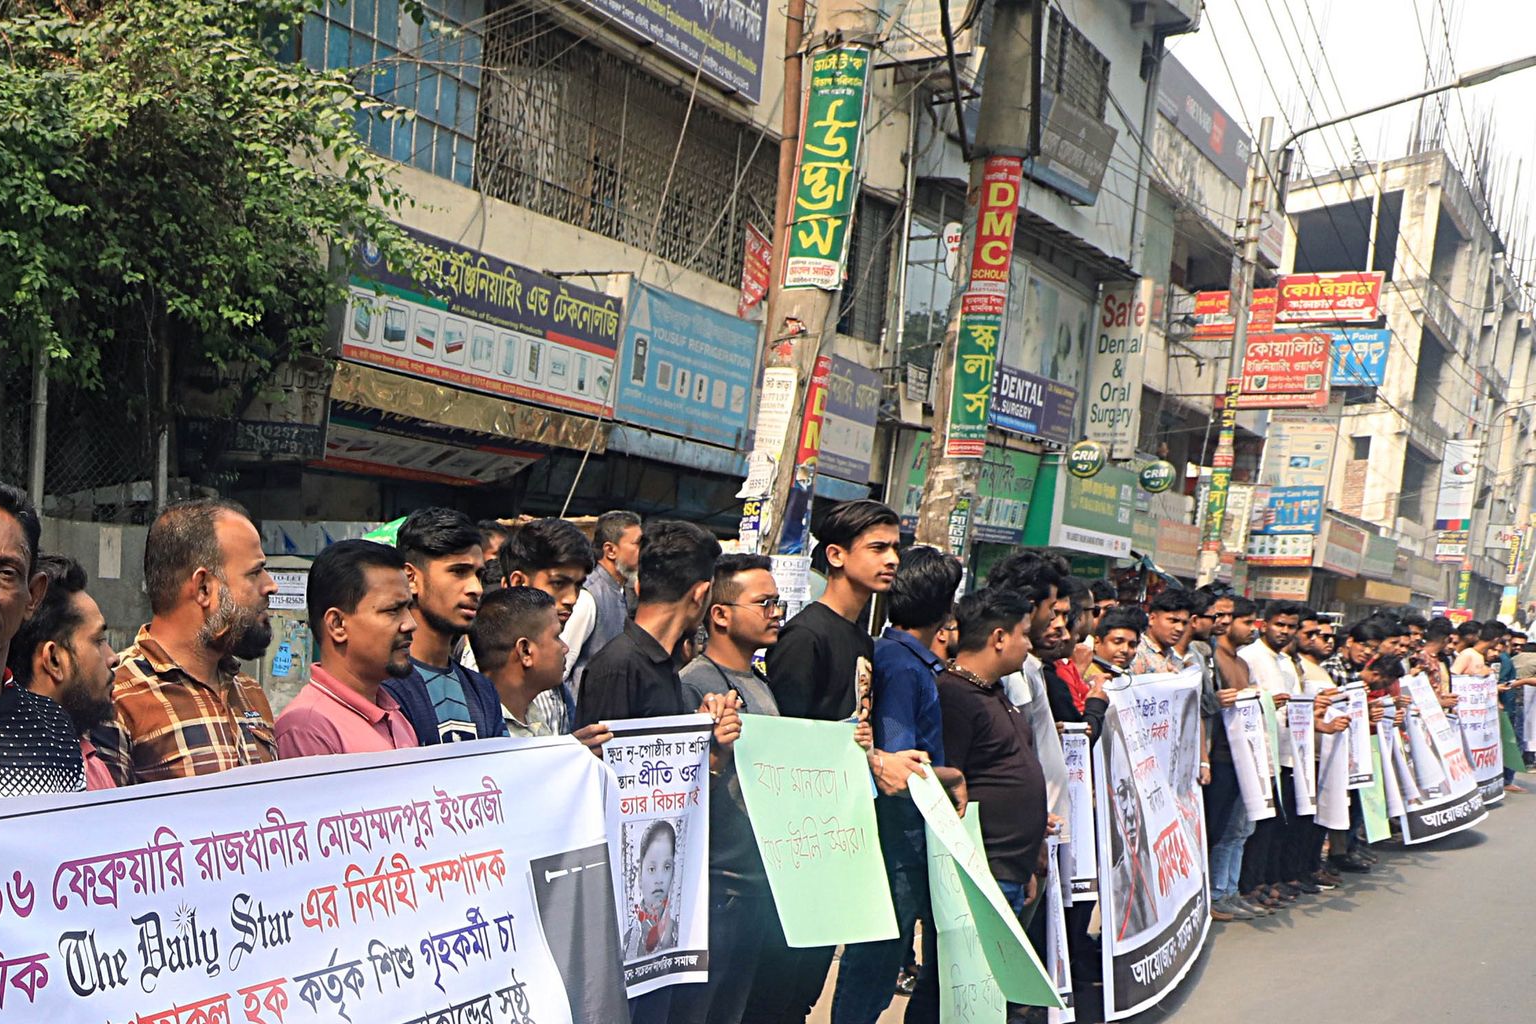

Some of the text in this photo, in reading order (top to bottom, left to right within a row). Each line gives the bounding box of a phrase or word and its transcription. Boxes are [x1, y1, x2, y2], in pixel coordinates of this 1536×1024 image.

[1112, 359, 1122, 378] &
[1000, 373, 1044, 407] DENTAL
[1002, 400, 1032, 420] SURGERY
[1072, 450, 1099, 461] CRM
[676, 742, 685, 755] চা
[689, 736, 709, 753] শ্রমি
[618, 775, 636, 789] ন্তান
[639, 760, 673, 787] প্রীতি
[620, 796, 648, 815] ত্যার
[652, 789, 686, 812] বিচার
[52, 826, 184, 912] ফেব্রুয়ারি
[191, 806, 308, 883] রাজধানীর
[316, 796, 433, 859] মোহাম্মদপুর
[434, 777, 504, 835] ইংরেজী
[58, 930, 128, 999] The
[135, 902, 220, 994] Daily
[230, 892, 296, 973] Star
[300, 876, 340, 933] এর
[344, 855, 417, 923] নির্বাহী
[421, 848, 506, 904] সম্পাদক
[294, 950, 364, 1023] কর্তৃক
[367, 937, 414, 994] শিশু
[419, 907, 489, 994] গৃহকর্মী
[494, 912, 517, 955] চা
[674, 955, 699, 966] সমাজ
